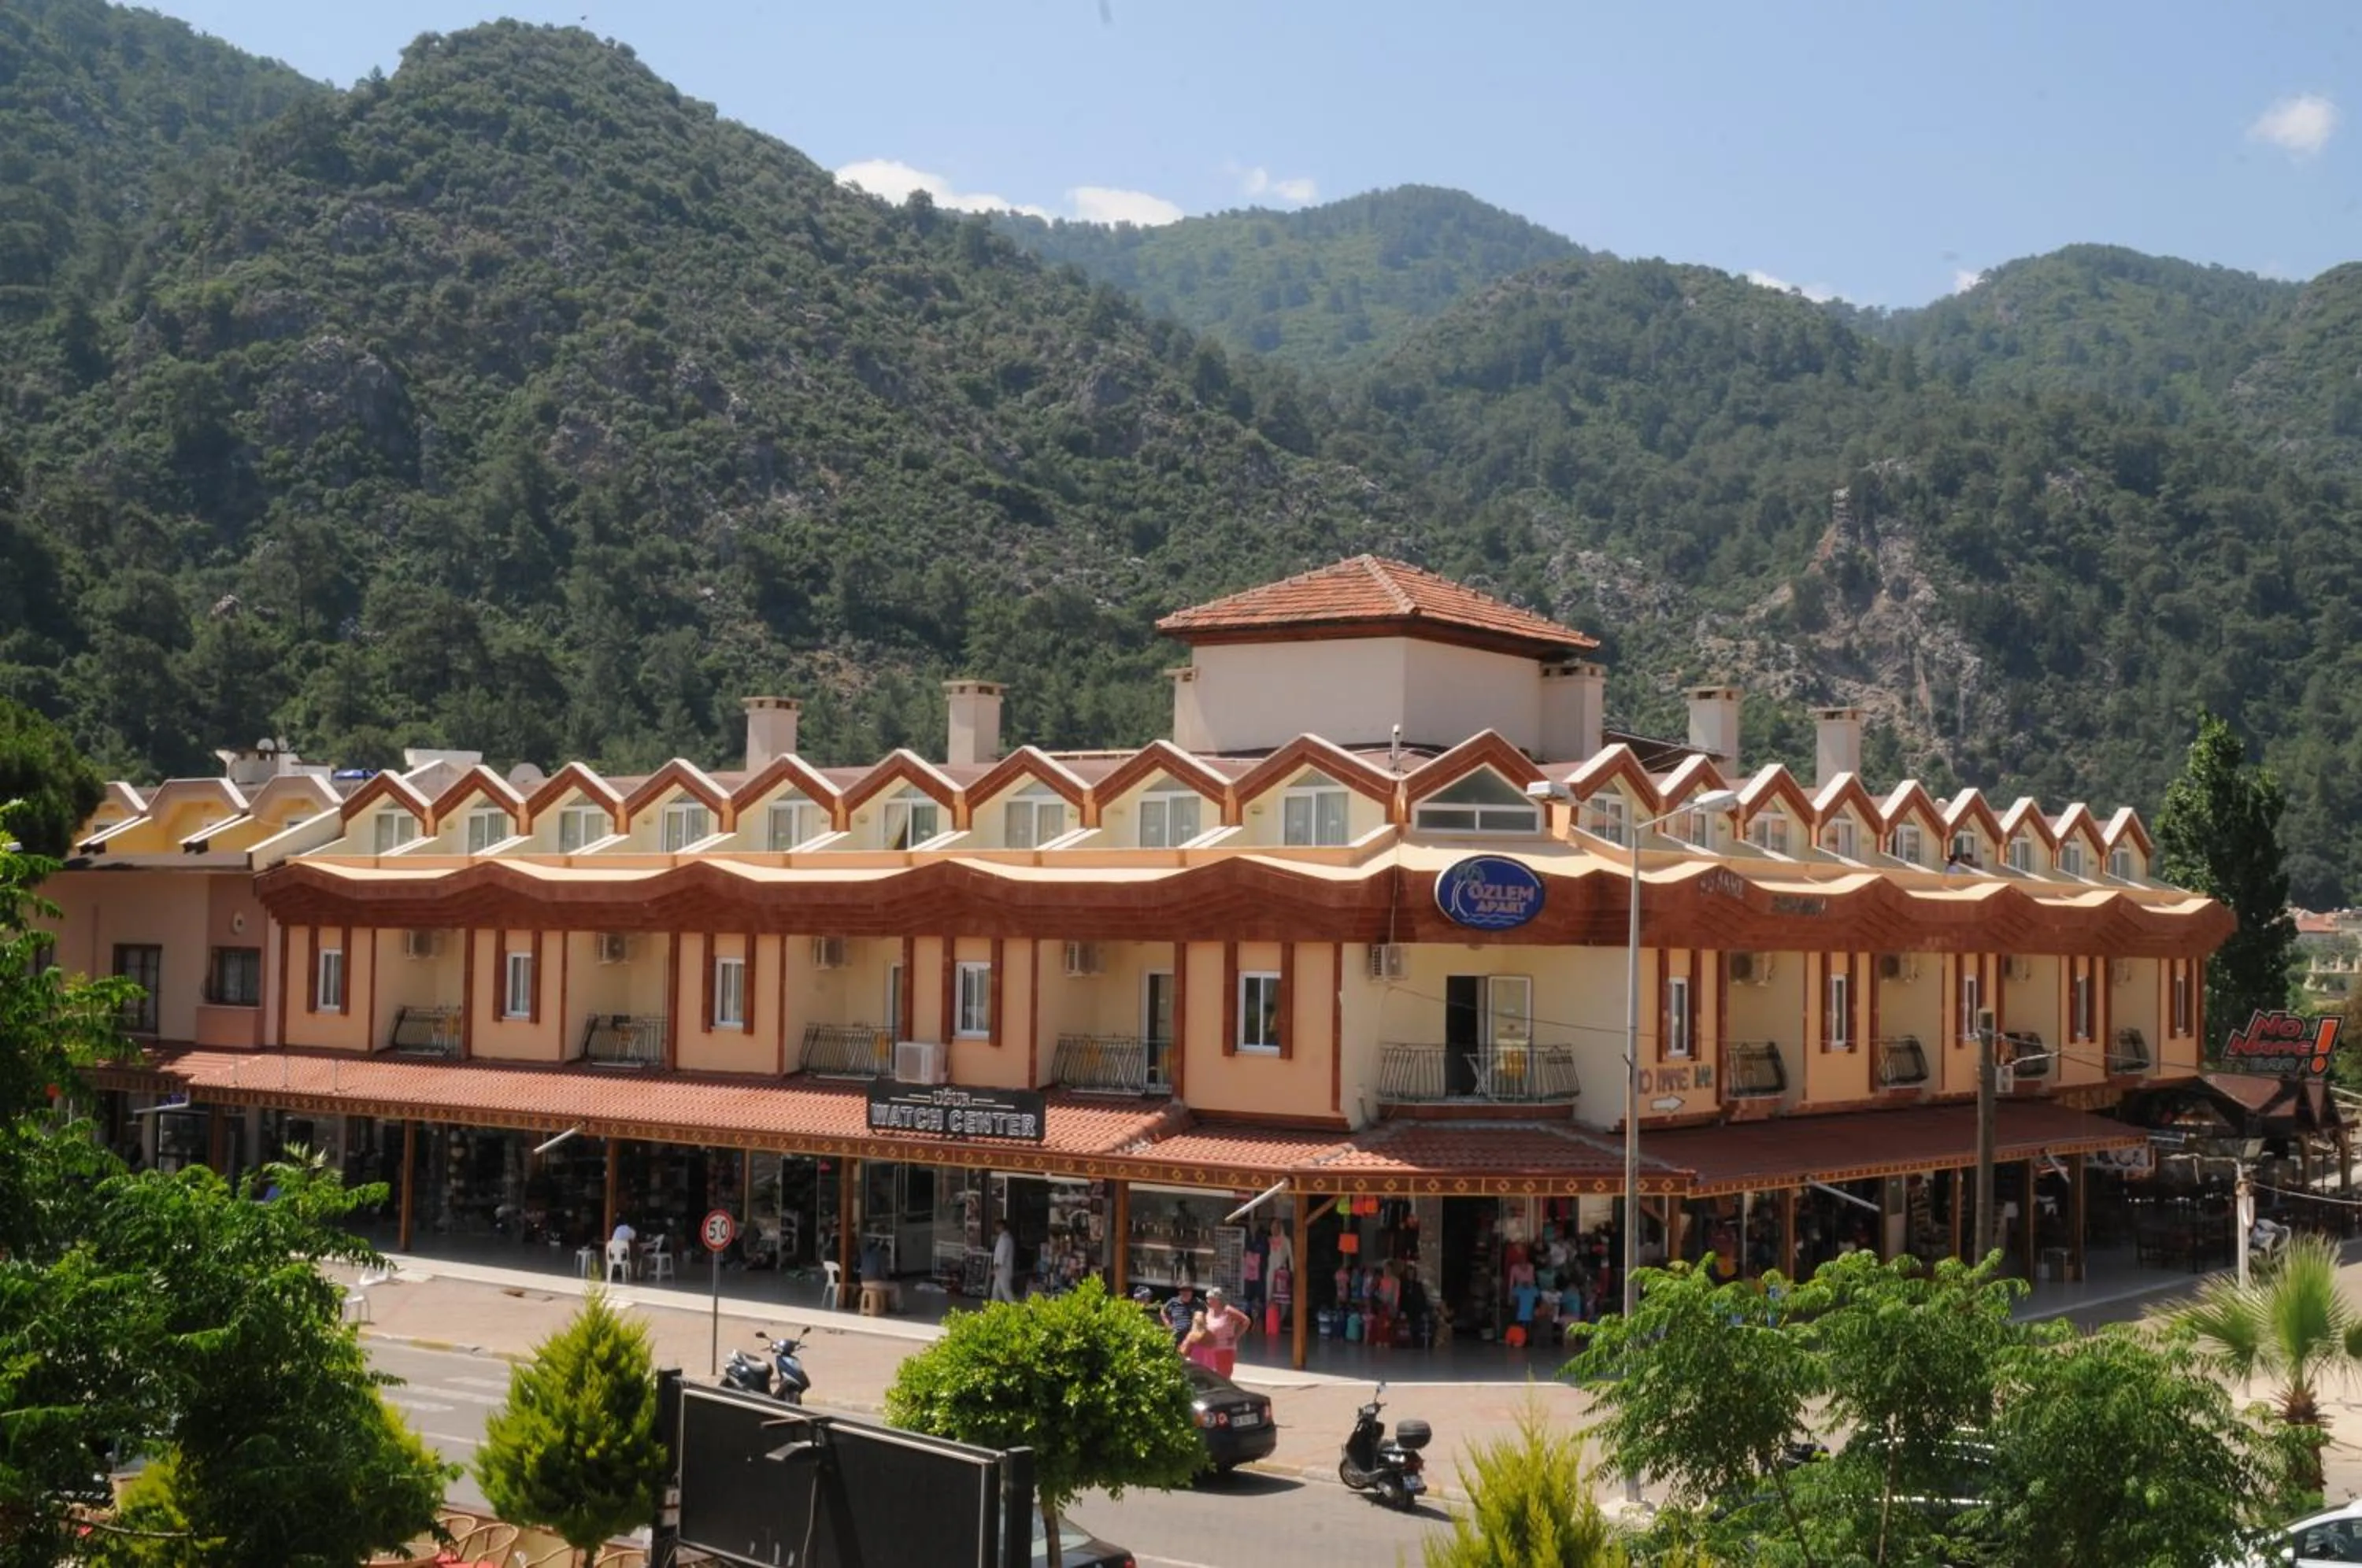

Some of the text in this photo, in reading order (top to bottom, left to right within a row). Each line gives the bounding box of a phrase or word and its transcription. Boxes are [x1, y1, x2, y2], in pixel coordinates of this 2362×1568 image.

[871, 1103, 1036, 1137] WATCH CENTER
[709, 1221, 728, 1240] 50
